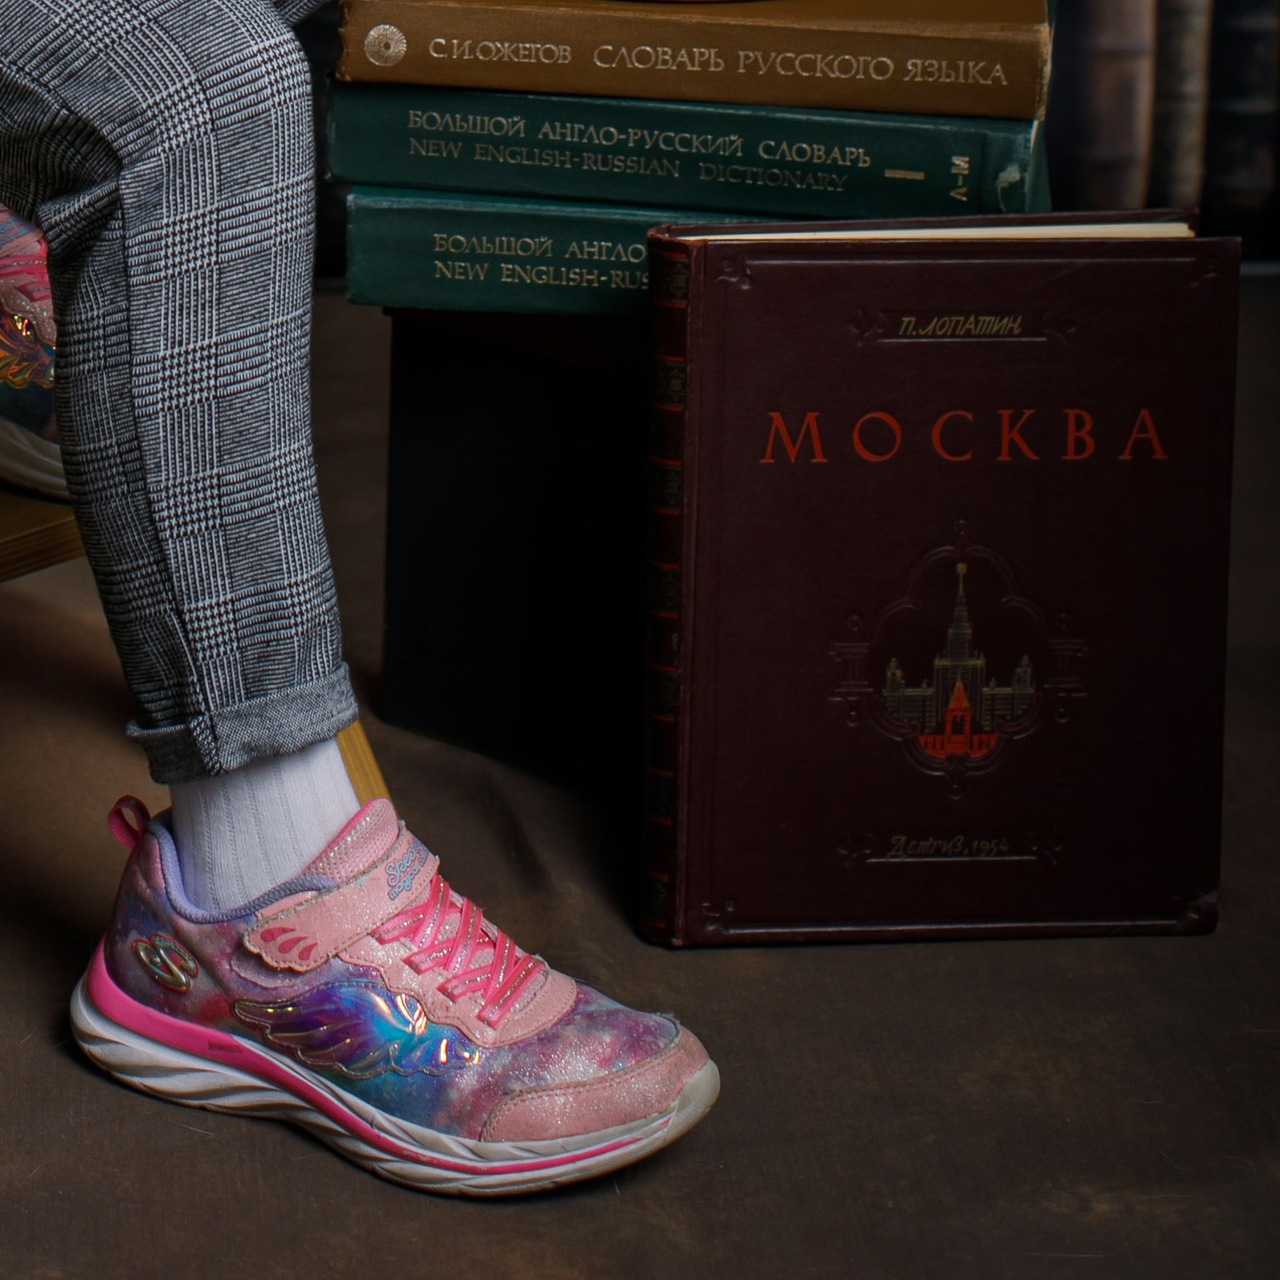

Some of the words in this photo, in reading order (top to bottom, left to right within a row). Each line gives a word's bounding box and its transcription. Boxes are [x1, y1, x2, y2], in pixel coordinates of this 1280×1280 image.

[593, 44, 726, 74] СЛОВАРЬ
[737, 49, 895, 82] РУССКОГО
[902, 56, 1009, 87] ЯЗЫКА
[408, 109, 526, 139] БОЛЬШОЙ
[540, 120, 744, 158] АНГЛО-РУССКИЙ
[758, 140, 872, 169] СЛОВАРЬ
[408, 137, 462, 160] NEW
[473, 140, 680, 179] ENGLISH-RUSSIAN
[698, 159, 849, 193] DICTIONARY
[433, 232, 554, 258] БОЛЬШОЙ
[434, 260, 490, 281] NEW
[759, 408, 1170, 464] МОСКВА
